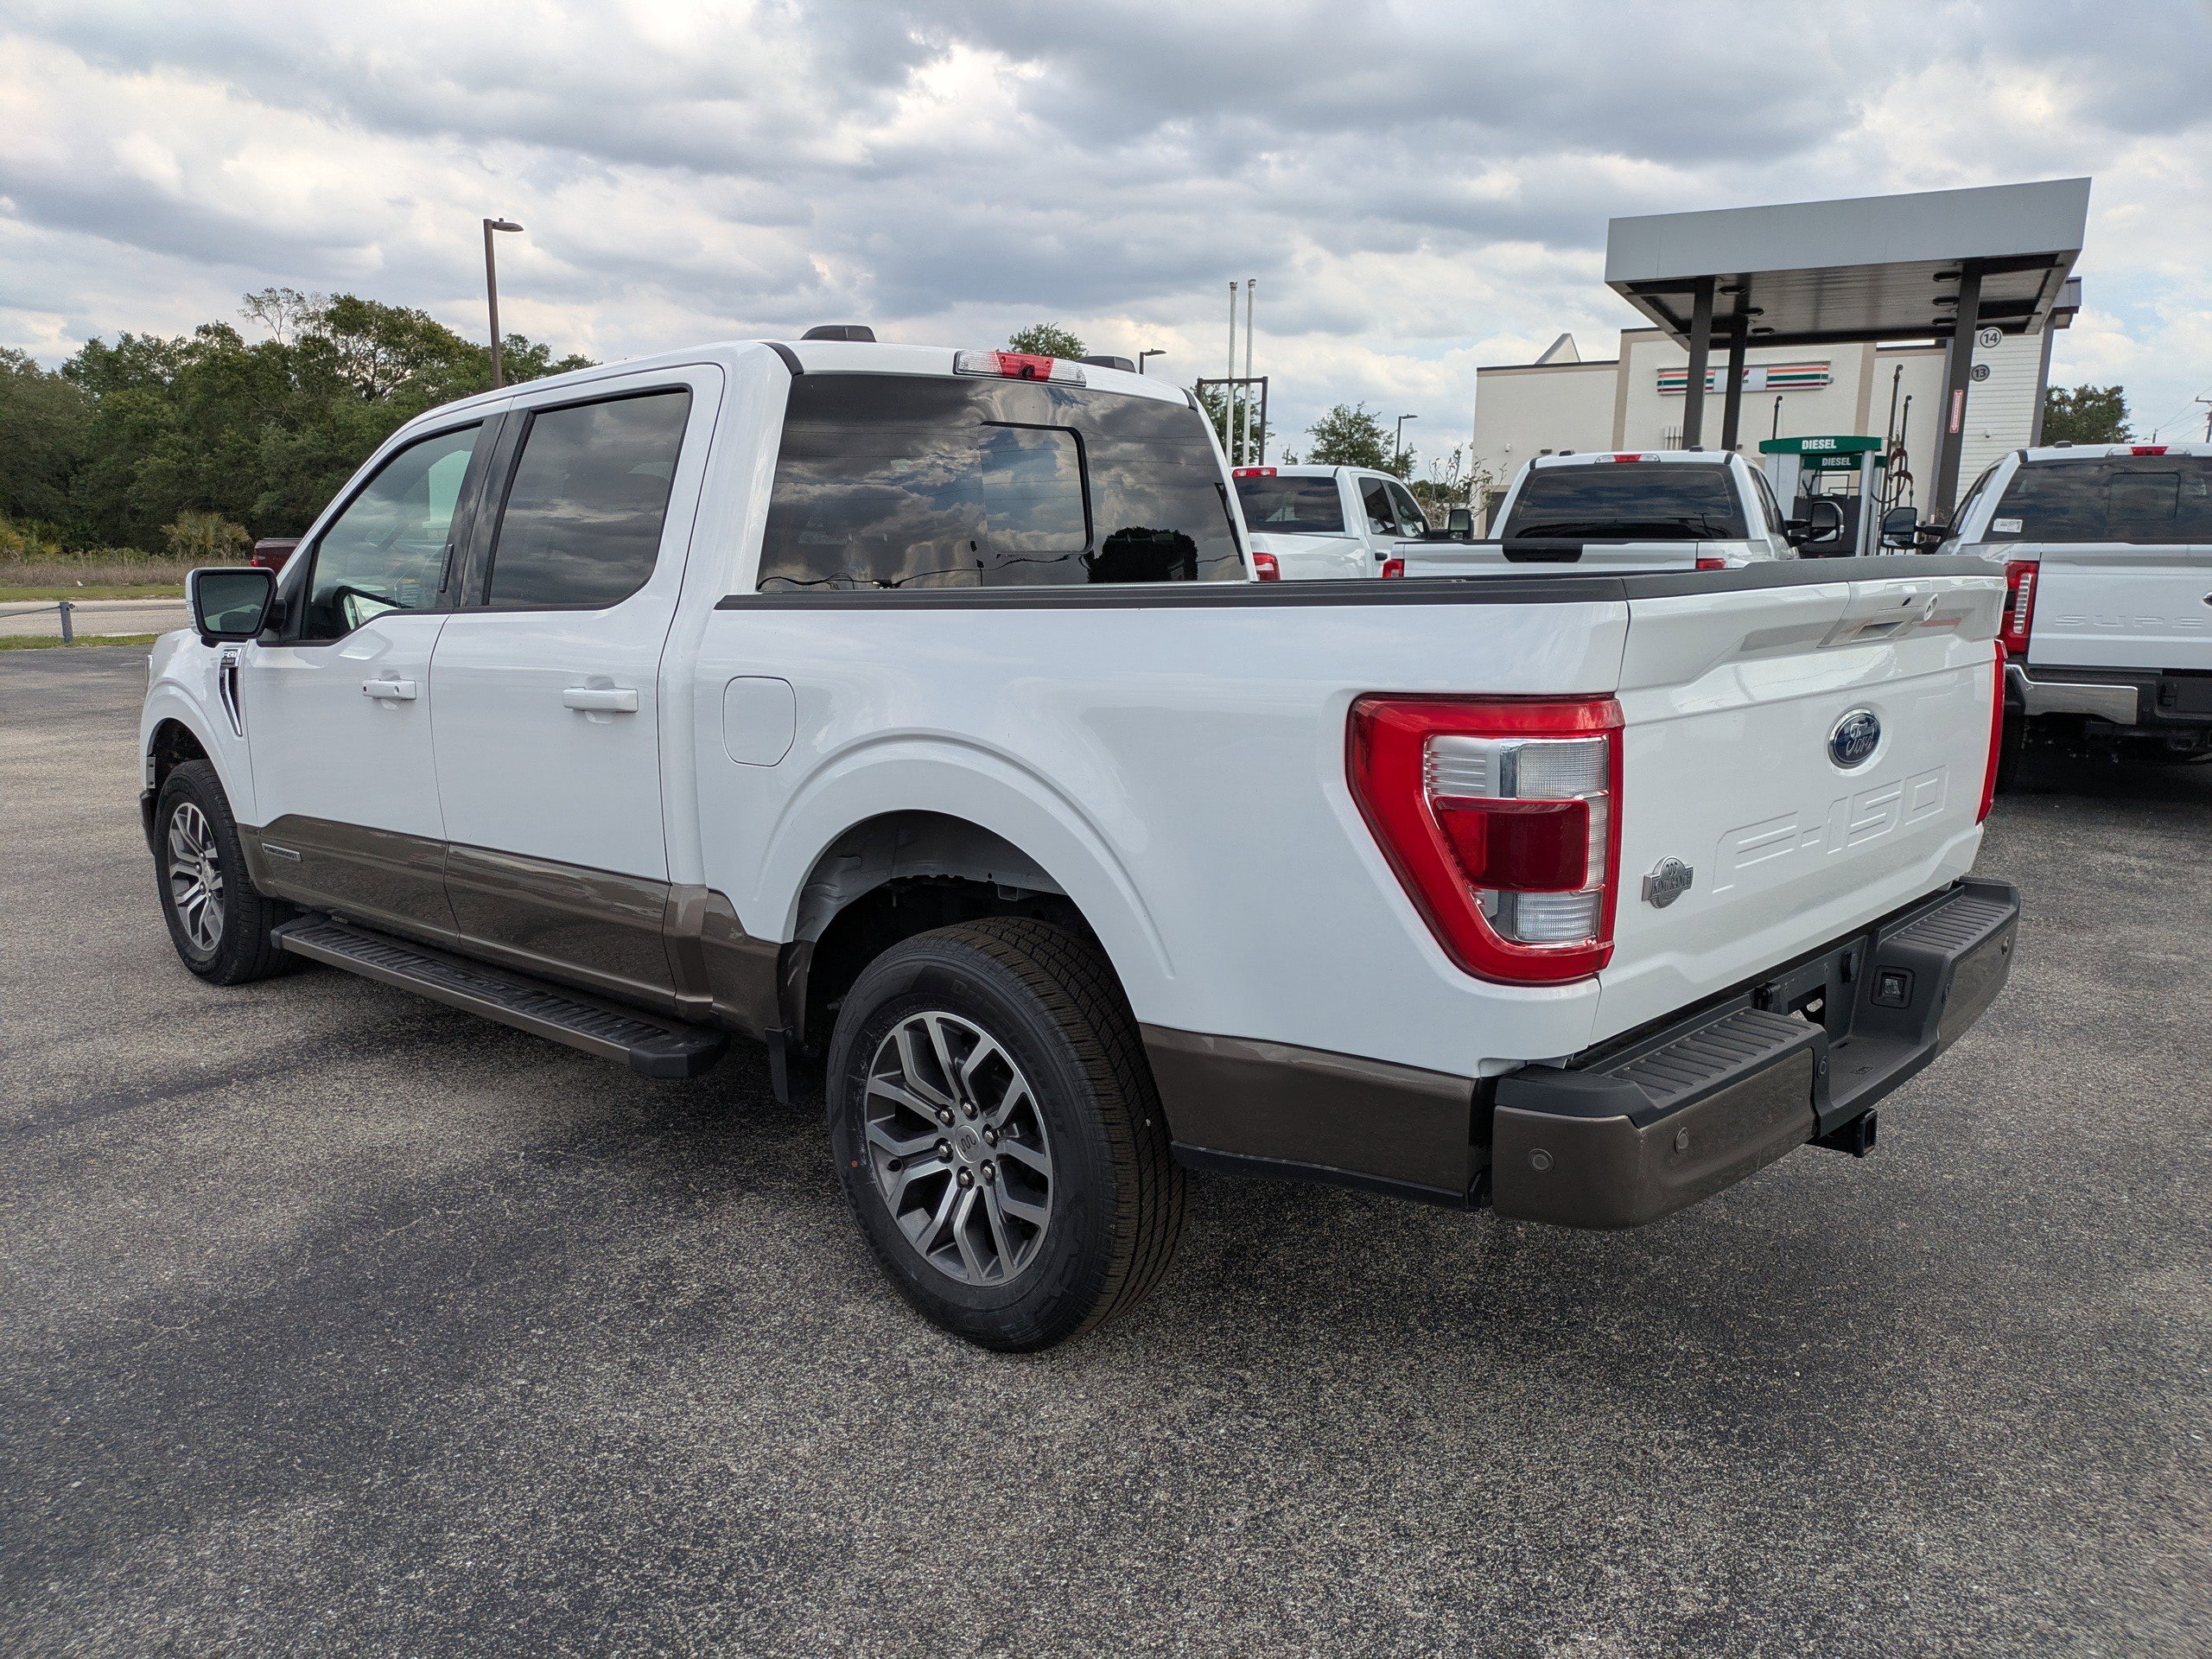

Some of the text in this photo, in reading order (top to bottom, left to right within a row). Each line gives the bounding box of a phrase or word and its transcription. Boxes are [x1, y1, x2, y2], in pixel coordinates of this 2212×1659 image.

[1984, 333, 1998, 344] 14
[1974, 369, 1986, 378] 13
[1802, 439, 1837, 449] DIESEL
[1821, 457, 1851, 467] DIESEL
[1846, 721, 1876, 757] Ford
[1712, 765, 1948, 893] F-150
[1652, 869, 1693, 895] KING RANCH
